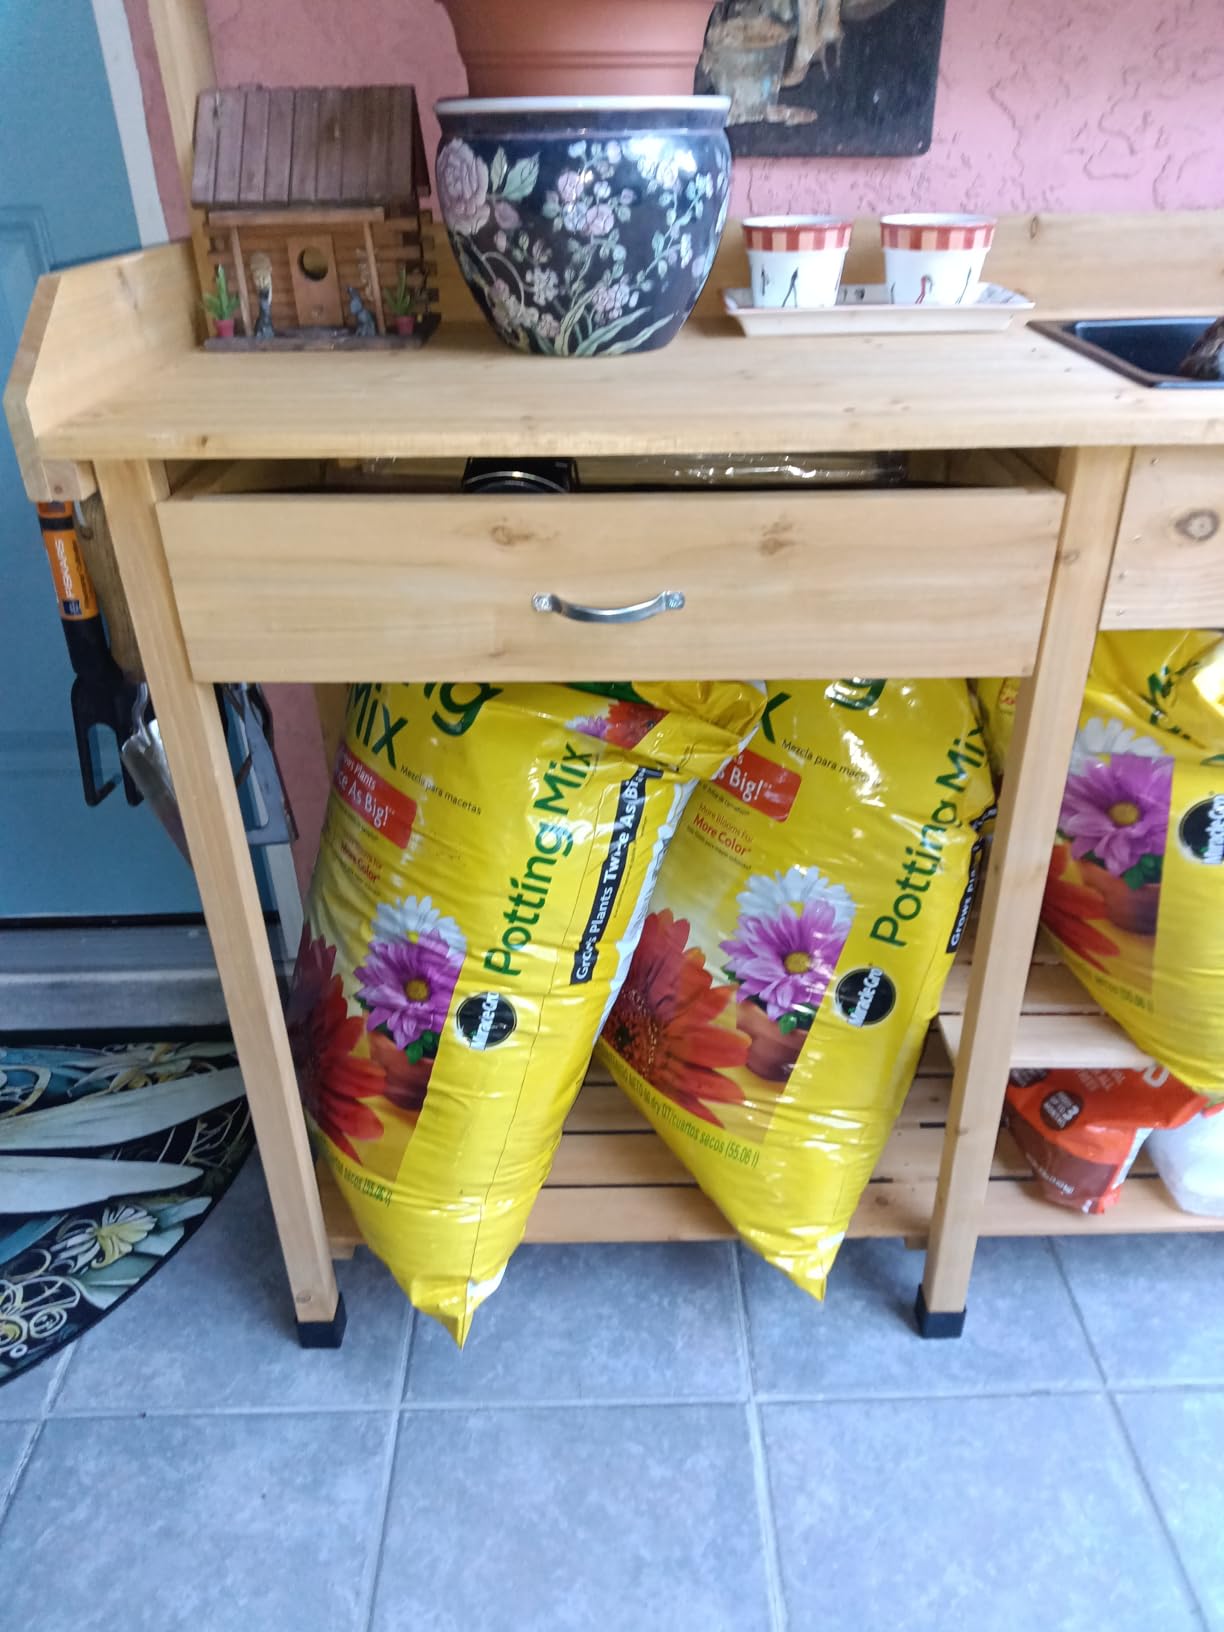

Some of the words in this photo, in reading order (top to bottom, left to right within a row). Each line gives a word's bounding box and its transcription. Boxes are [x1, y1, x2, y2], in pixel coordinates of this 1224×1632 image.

[54, 538, 73, 600] FISKARS
[353, 762, 376, 791] Plants
[781, 739, 814, 761] Mezcla
[814, 754, 837, 771] para
[839, 764, 881, 788] maceas
[348, 780, 362, 805] As
[400, 765, 426, 786] Mezcla
[425, 780, 443, 797] para
[444, 791, 482, 815] macetas
[483, 821, 574, 976] Potting
[532, 742, 593, 816] Mix
[693, 813, 718, 838] More
[718, 831, 748, 857] Color
[588, 886, 613, 936] Plants
[621, 801, 640, 830] As
[869, 799, 963, 947] Potting
[951, 897, 972, 947] Grows
[699, 1130, 725, 1154] secos
